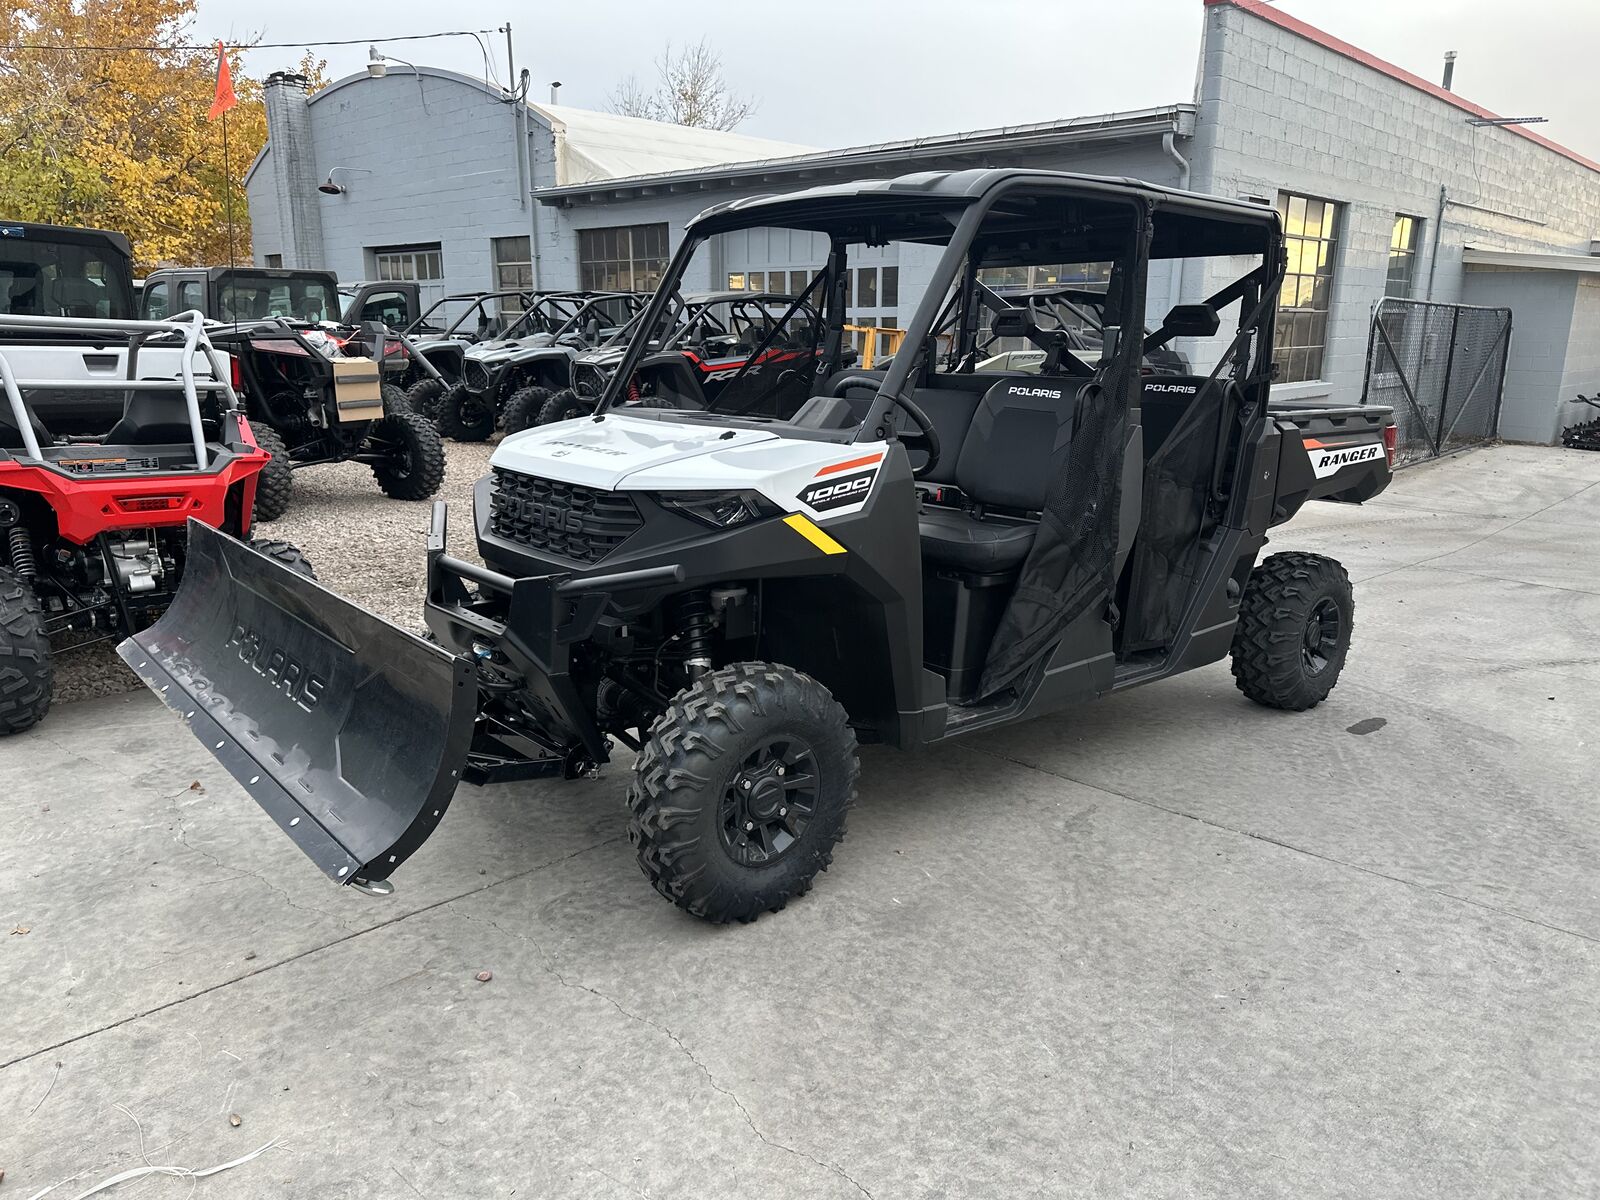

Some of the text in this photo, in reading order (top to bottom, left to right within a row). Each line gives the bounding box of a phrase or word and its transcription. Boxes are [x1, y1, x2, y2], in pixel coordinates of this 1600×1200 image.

[1008, 386, 1062, 399] POLARIS
[1144, 384, 1197, 394] POLARIS
[1318, 447, 1378, 468] RANGER
[806, 476, 871, 502] 1000
[496, 492, 583, 534] POLARIS
[225, 623, 329, 713] POLARIS
